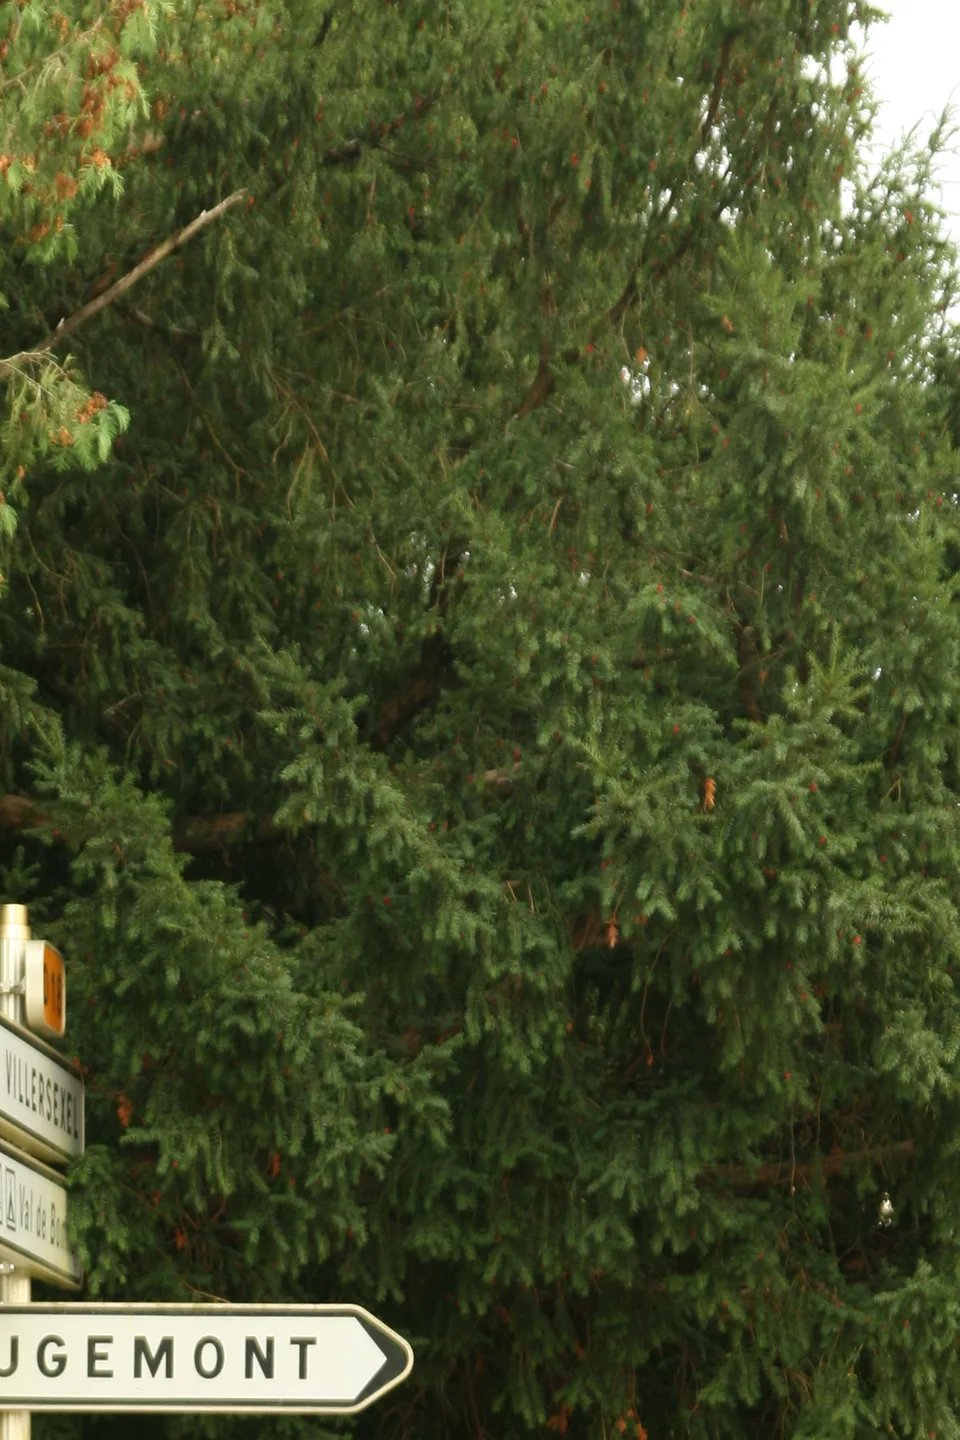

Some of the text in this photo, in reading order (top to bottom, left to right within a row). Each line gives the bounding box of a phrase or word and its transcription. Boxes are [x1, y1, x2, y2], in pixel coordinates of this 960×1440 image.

[6, 1050, 78, 1139] VILLERSEXEL
[20, 1183, 33, 1232] Val
[37, 1194, 46, 1240] de
